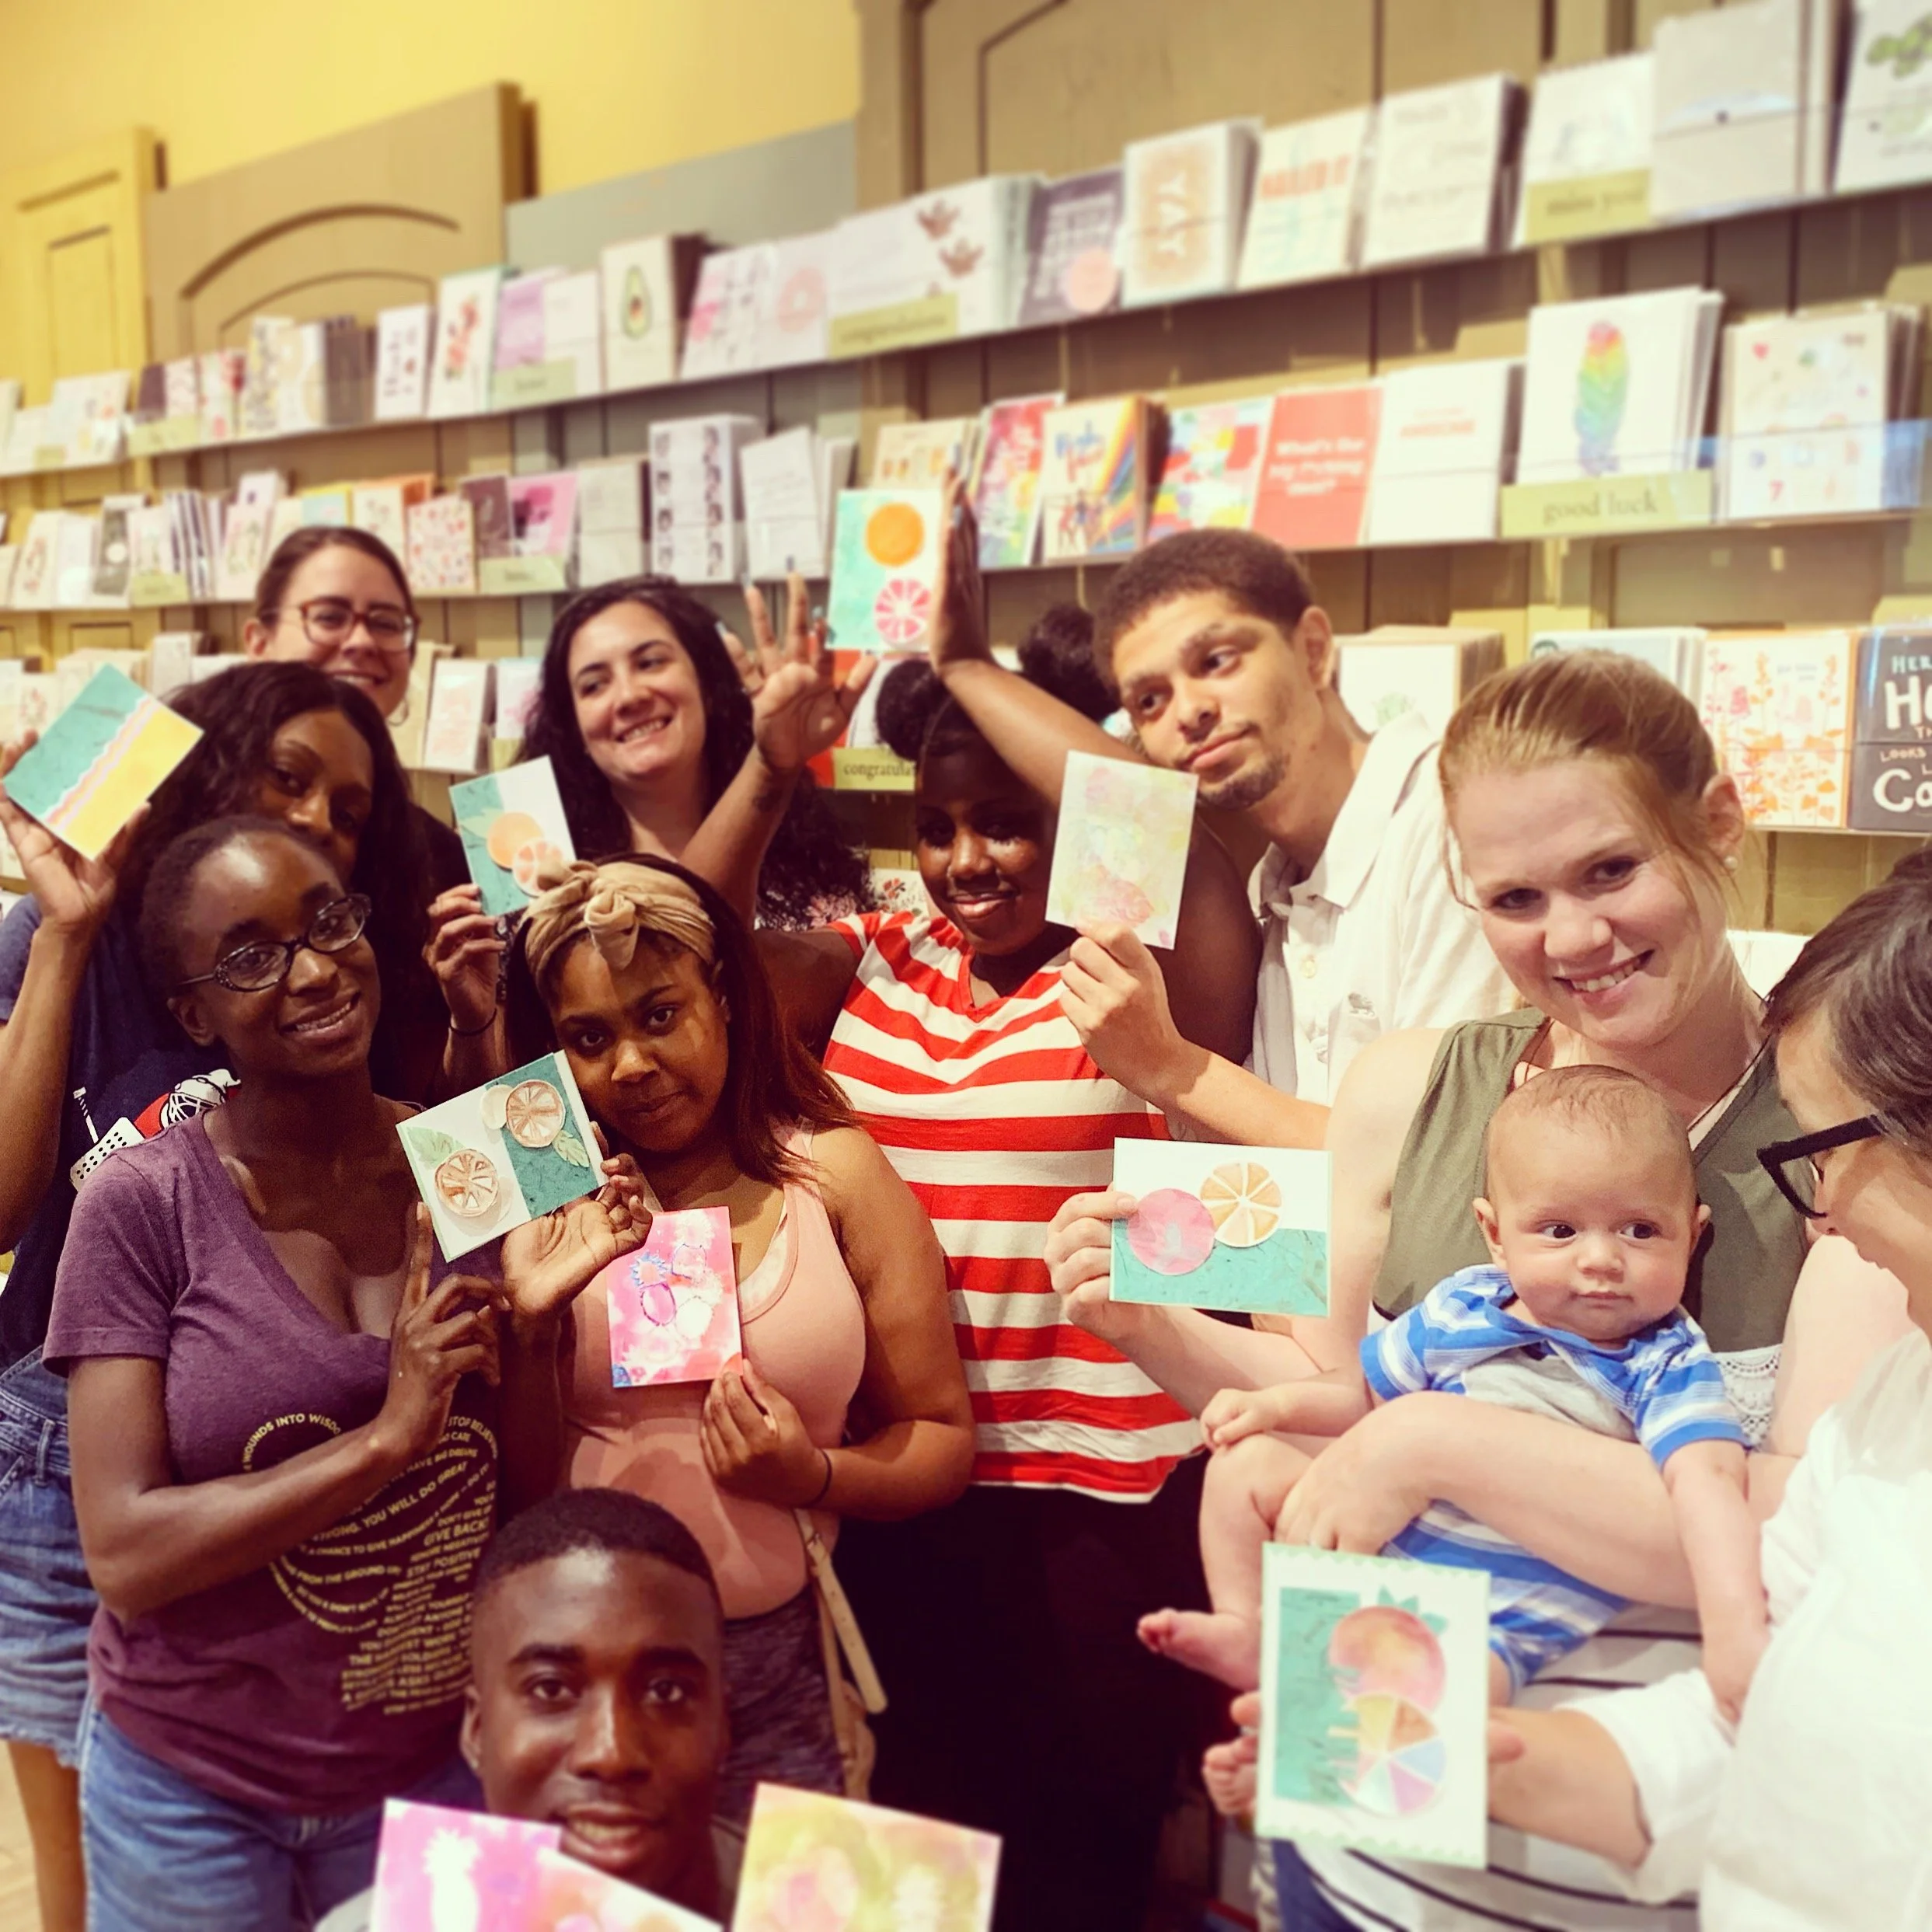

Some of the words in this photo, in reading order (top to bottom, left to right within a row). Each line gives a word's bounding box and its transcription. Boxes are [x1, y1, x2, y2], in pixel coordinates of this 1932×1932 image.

[1157, 169, 1187, 258] YAY
[1543, 491, 1600, 527] good
[1607, 488, 1659, 516] luck
[1880, 748, 1927, 762] LOOKS
[448, 1416, 471, 1427] STOP
[242, 1421, 274, 1463] WOUNDS
[276, 1413, 305, 1428] INTO
[309, 1413, 341, 1435] WISDO
[361, 1509, 387, 1528] YOU
[387, 1494, 420, 1515] WILL
[419, 1480, 437, 1498] DO
[438, 1460, 467, 1484] GREAT
[353, 1544, 366, 1554] TO
[367, 1540, 387, 1553] GIVE
[424, 1527, 452, 1547] GIVE
[433, 1547, 481, 1568] POSITIVE
[325, 1573, 342, 1585] THE
[344, 1565, 385, 1581] GROUND
